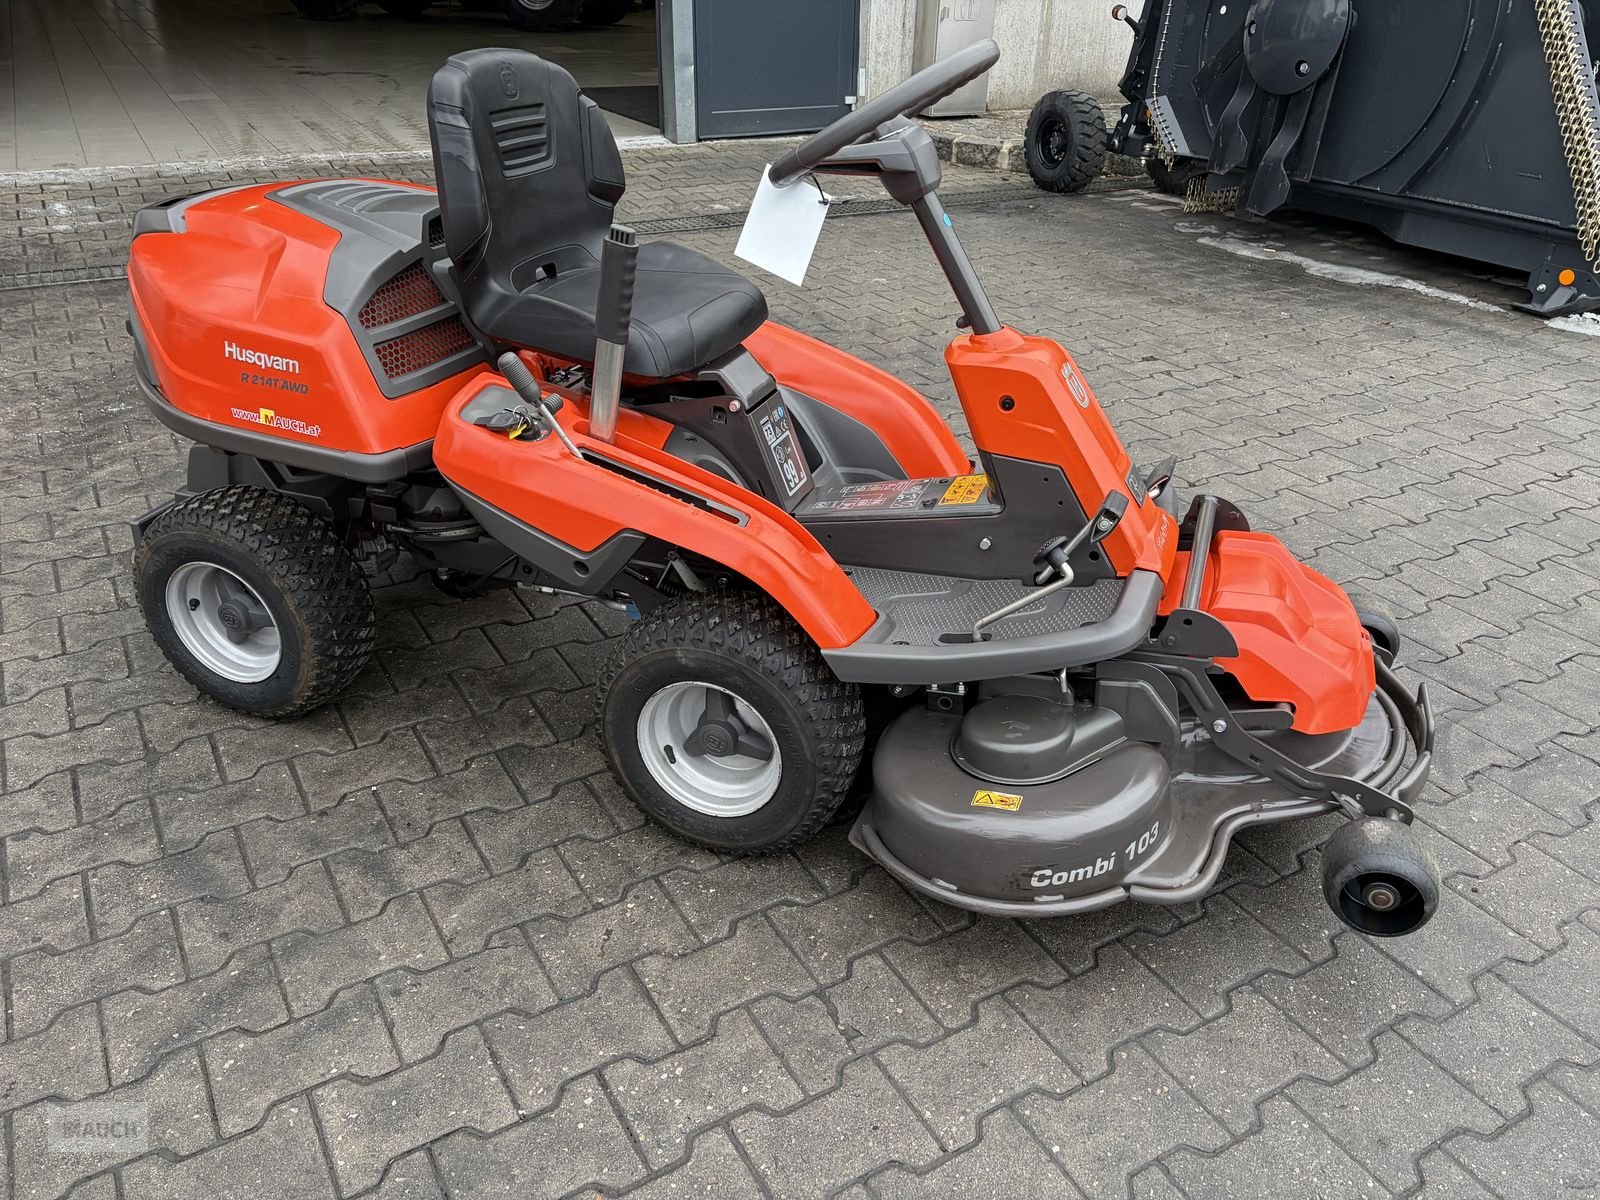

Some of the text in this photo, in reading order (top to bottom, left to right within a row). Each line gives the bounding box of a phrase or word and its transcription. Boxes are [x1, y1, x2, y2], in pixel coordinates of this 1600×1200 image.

[241, 372, 249, 383] R
[280, 380, 309, 394] AWD
[783, 459, 799, 488] 99
[1031, 821, 1159, 887] Combi 103
